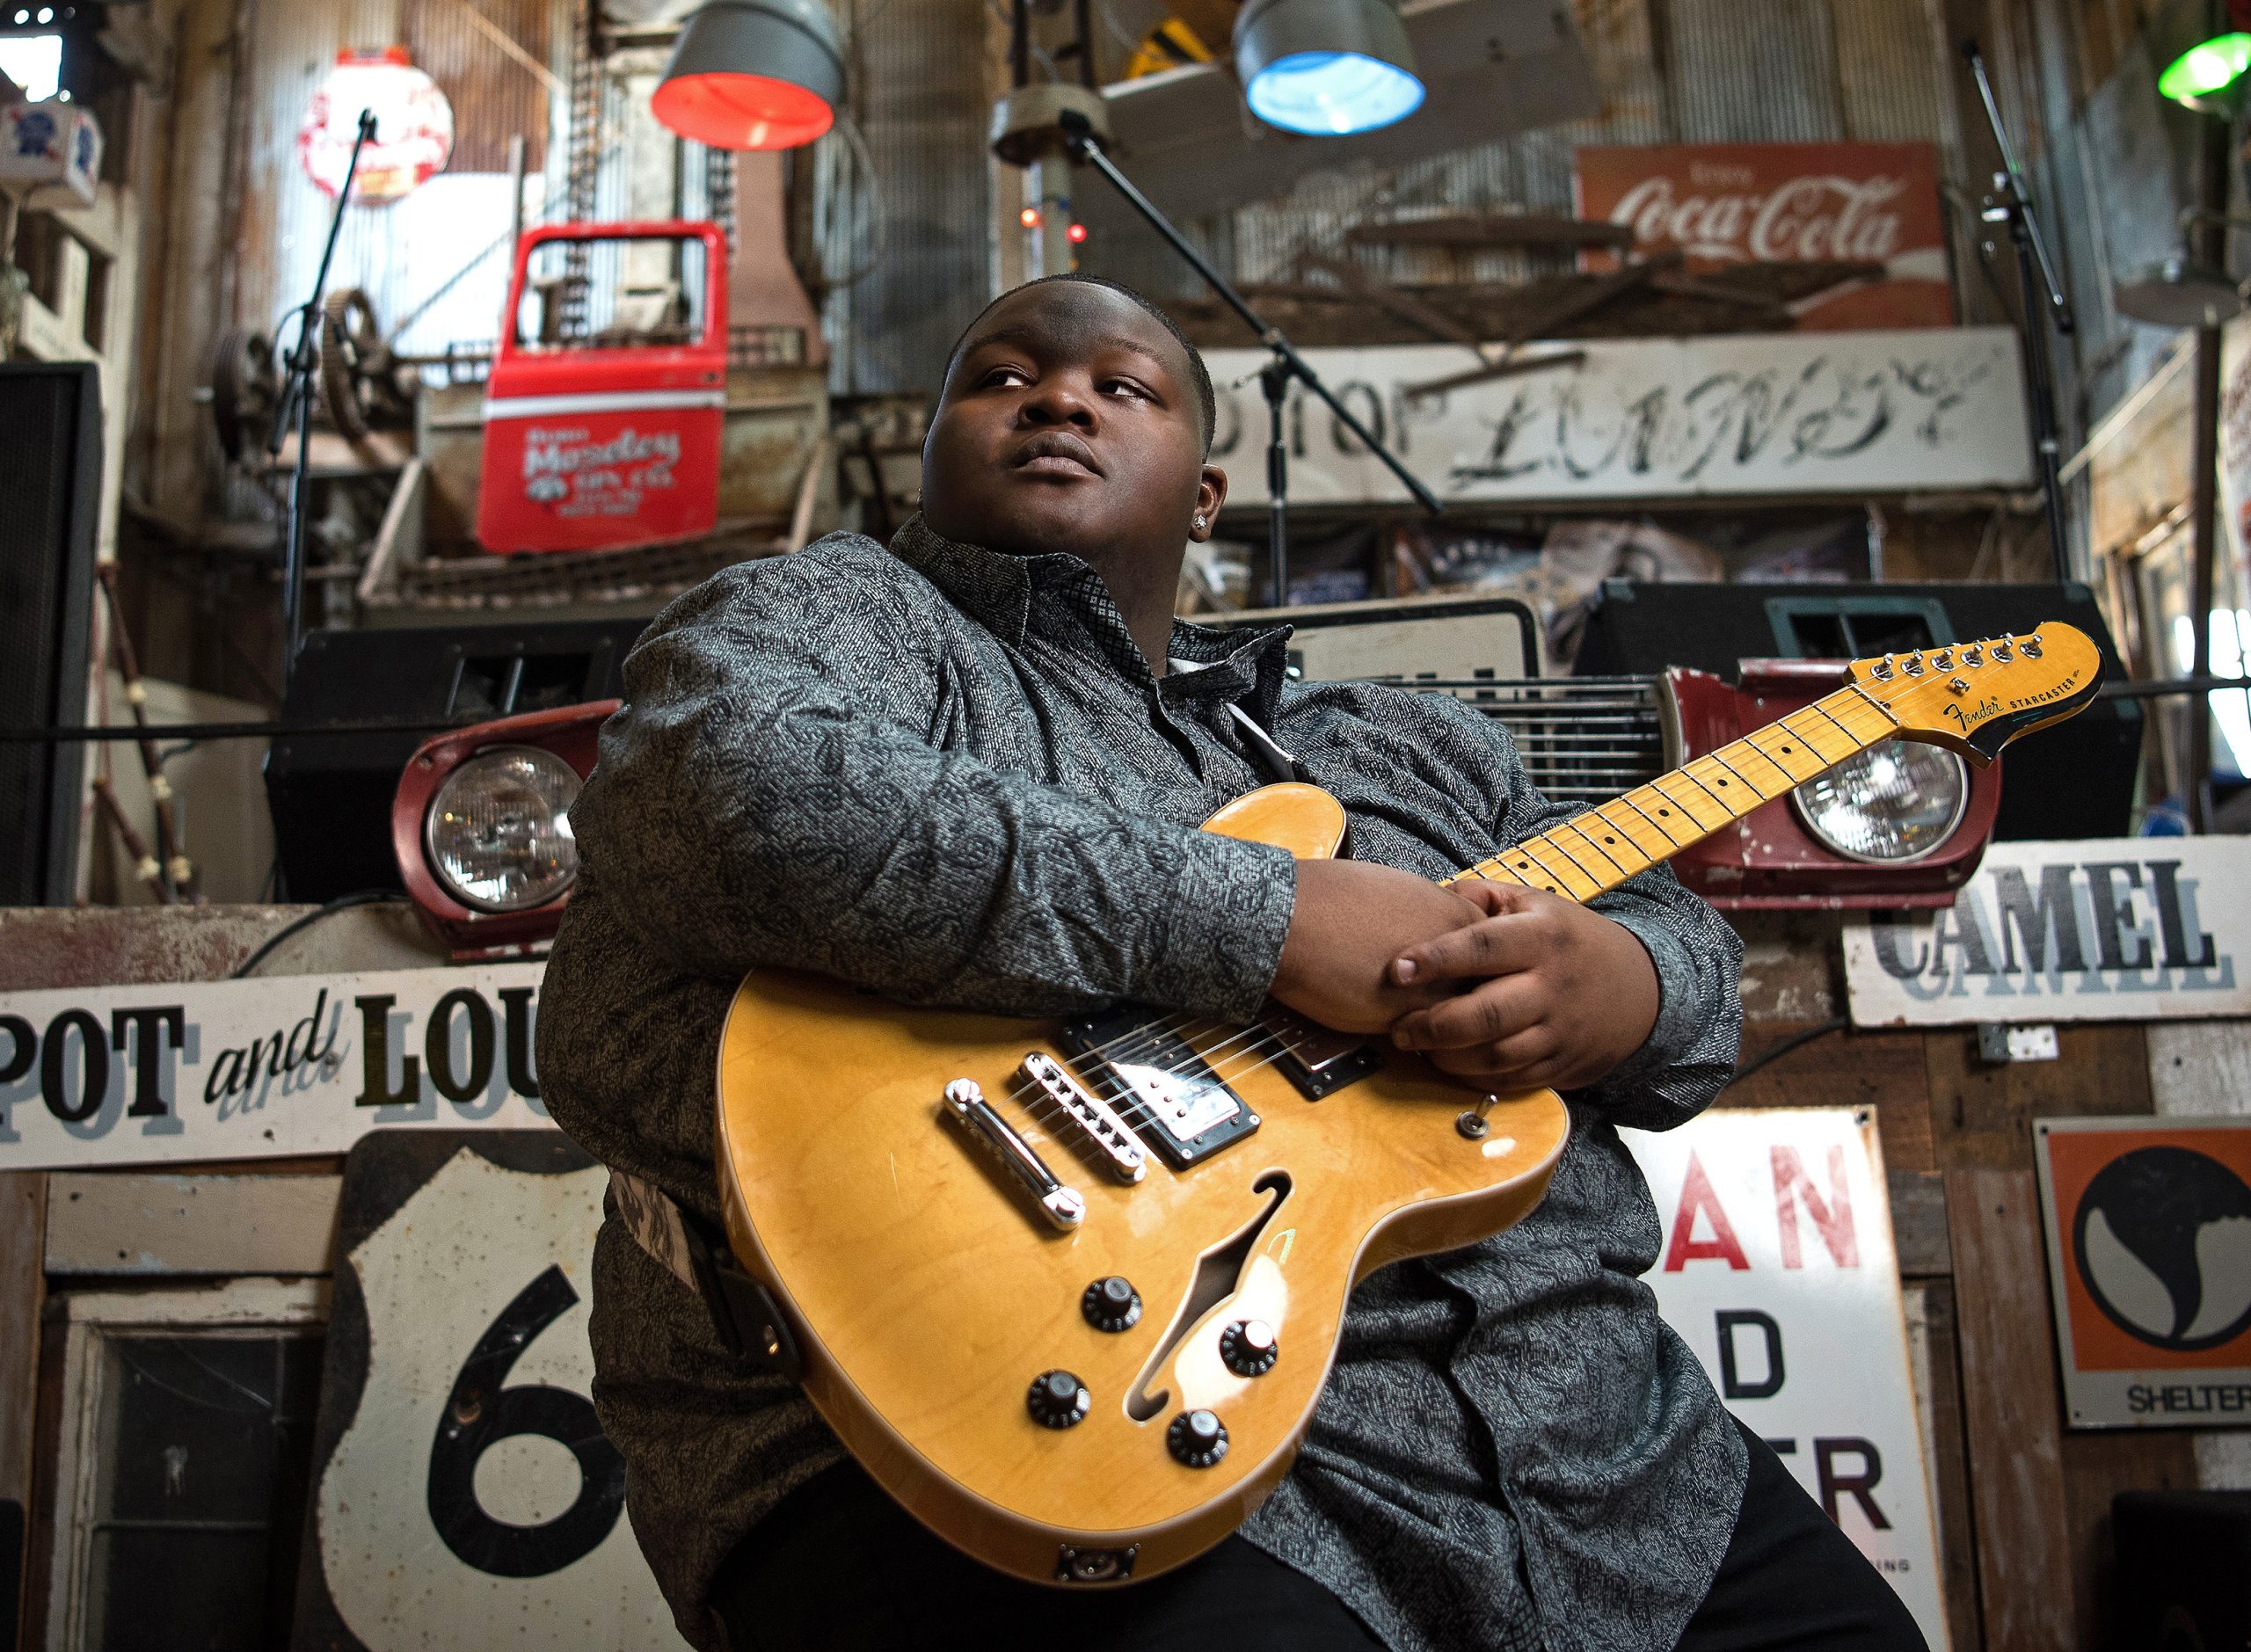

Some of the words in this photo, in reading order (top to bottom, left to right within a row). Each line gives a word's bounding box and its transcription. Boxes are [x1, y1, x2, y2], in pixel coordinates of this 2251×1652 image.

[1942, 697, 2005, 732] Fender
[2009, 677, 2076, 710] STARCASTER
[1869, 859, 2218, 979] CAMEL
[204, 986, 339, 1104] and
[1715, 1307, 1786, 1400] D
